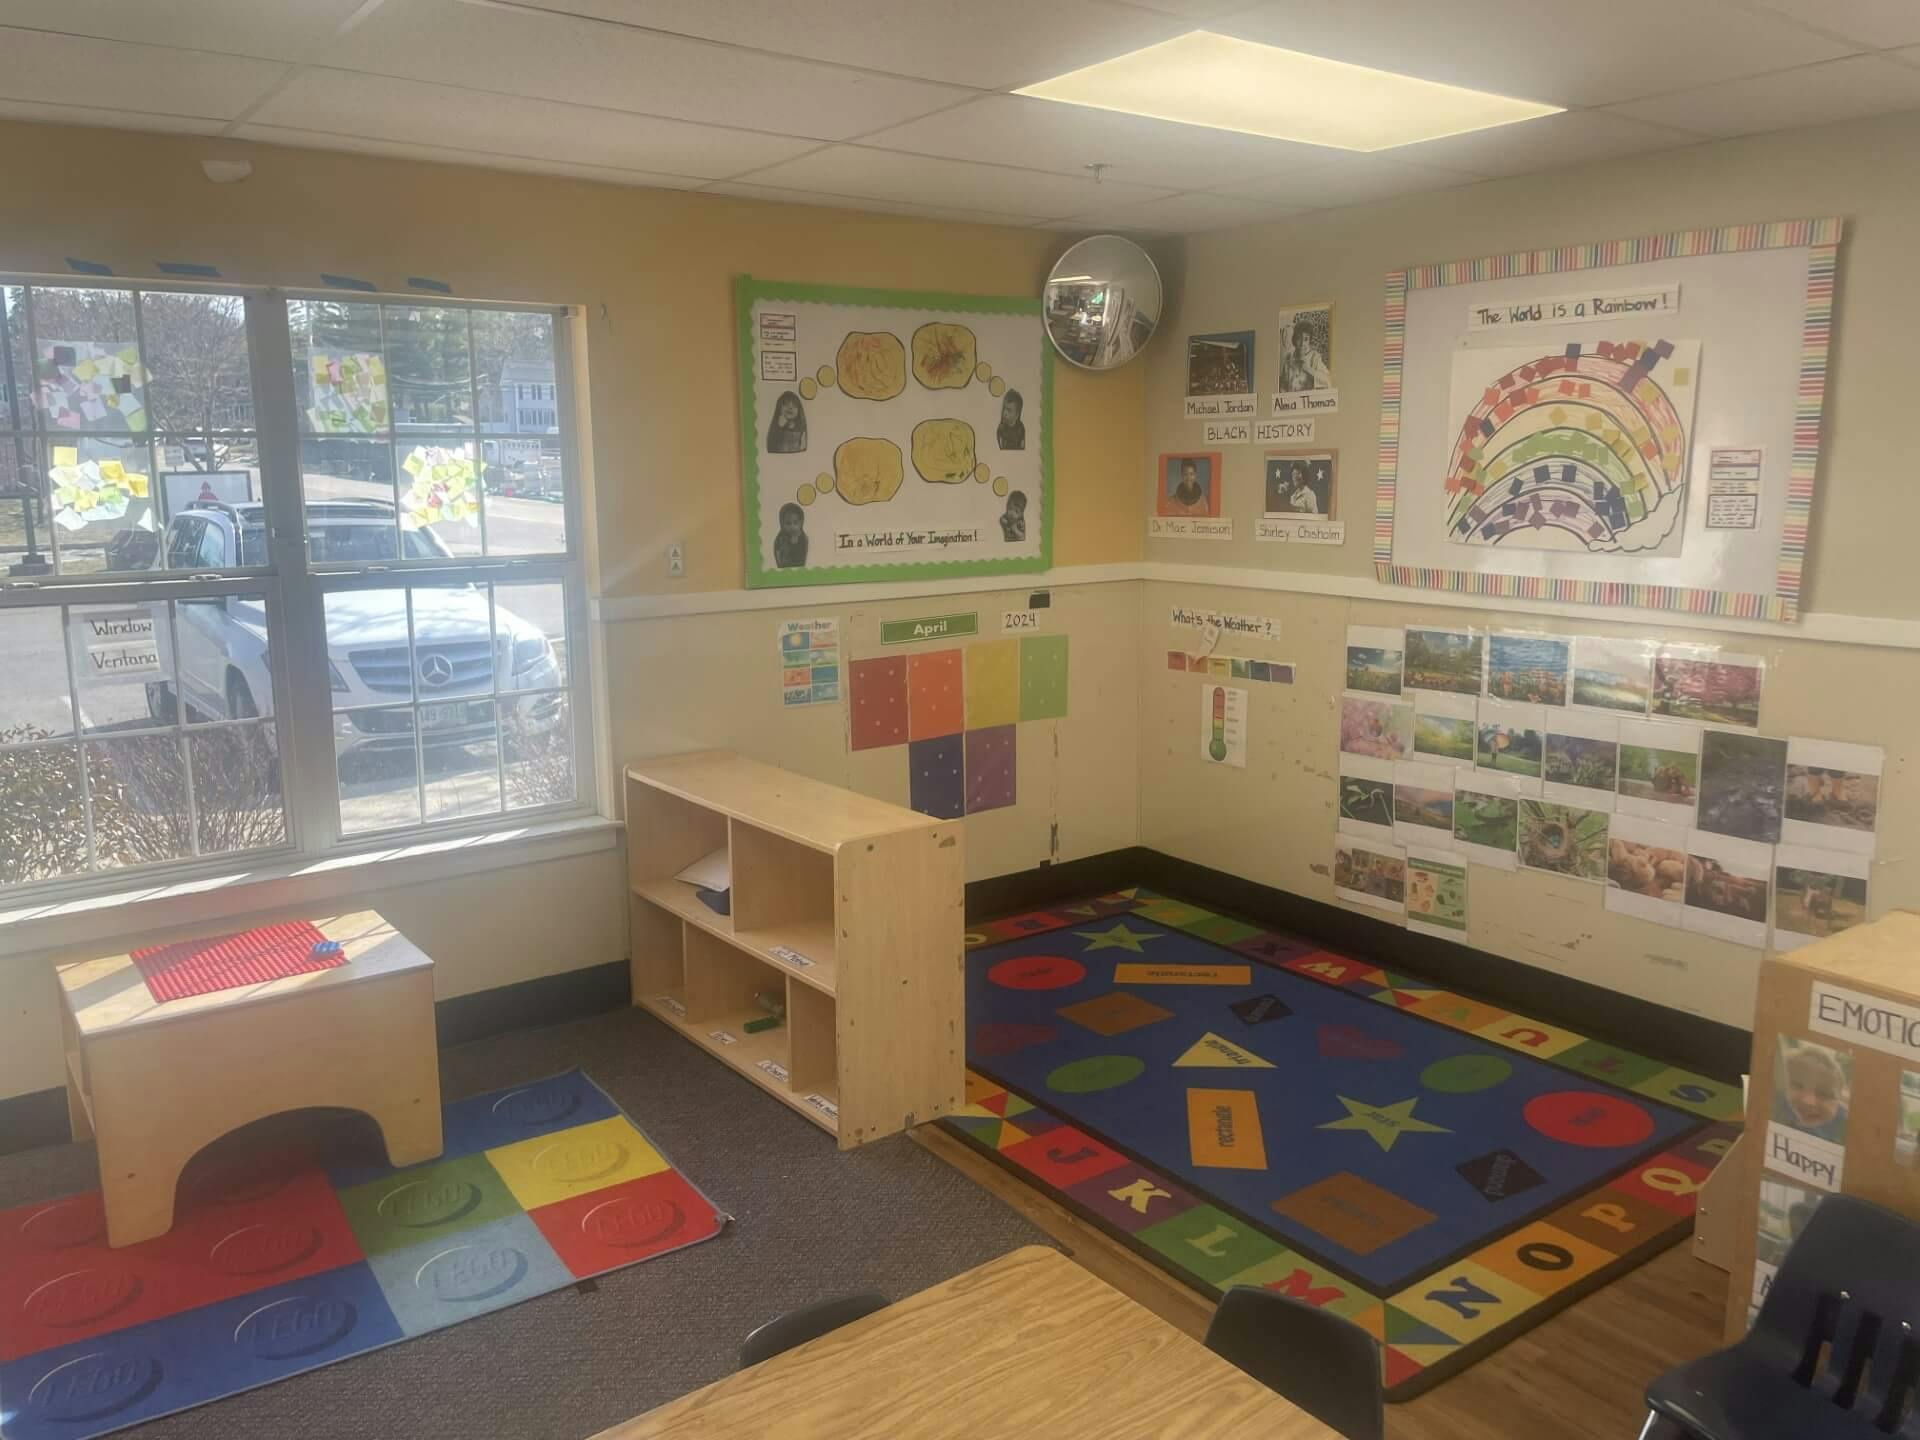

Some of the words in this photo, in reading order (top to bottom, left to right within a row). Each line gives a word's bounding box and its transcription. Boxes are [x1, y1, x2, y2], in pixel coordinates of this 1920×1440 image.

[1477, 308, 1502, 325] The
[1509, 303, 1543, 324] World
[1552, 304, 1567, 318] is
[1574, 303, 1585, 318] a
[1186, 401, 1220, 415] Michael
[1224, 400, 1255, 414] Jordan
[1274, 397, 1297, 412] Alma
[1299, 394, 1336, 410] Thomas
[1207, 426, 1248, 441] BLACK
[1257, 423, 1313, 440] HISTORY
[838, 533, 854, 549] In
[865, 532, 893, 547] World
[895, 531, 905, 546] of
[906, 531, 926, 545] Your
[1259, 524, 1290, 542] Shirley
[1297, 525, 1341, 541] Chisholm
[90, 617, 153, 636] Window
[787, 619, 833, 632] Weather
[1004, 612, 1037, 629] 2024
[1172, 607, 1204, 626] What's
[914, 620, 948, 636] April
[91, 648, 159, 669] Ventana
[1669, 1083, 1716, 1104] S
[1046, 1145, 1099, 1165] J
[1772, 1131, 1836, 1187] Happy
[1641, 1166, 1702, 1197] Q
[1107, 1178, 1172, 1215] K
[1582, 1202, 1636, 1234] P
[1185, 1223, 1239, 1257] L
[1517, 1241, 1575, 1272] O
[1262, 1268, 1346, 1308] M
[1424, 1275, 1503, 1320] N
